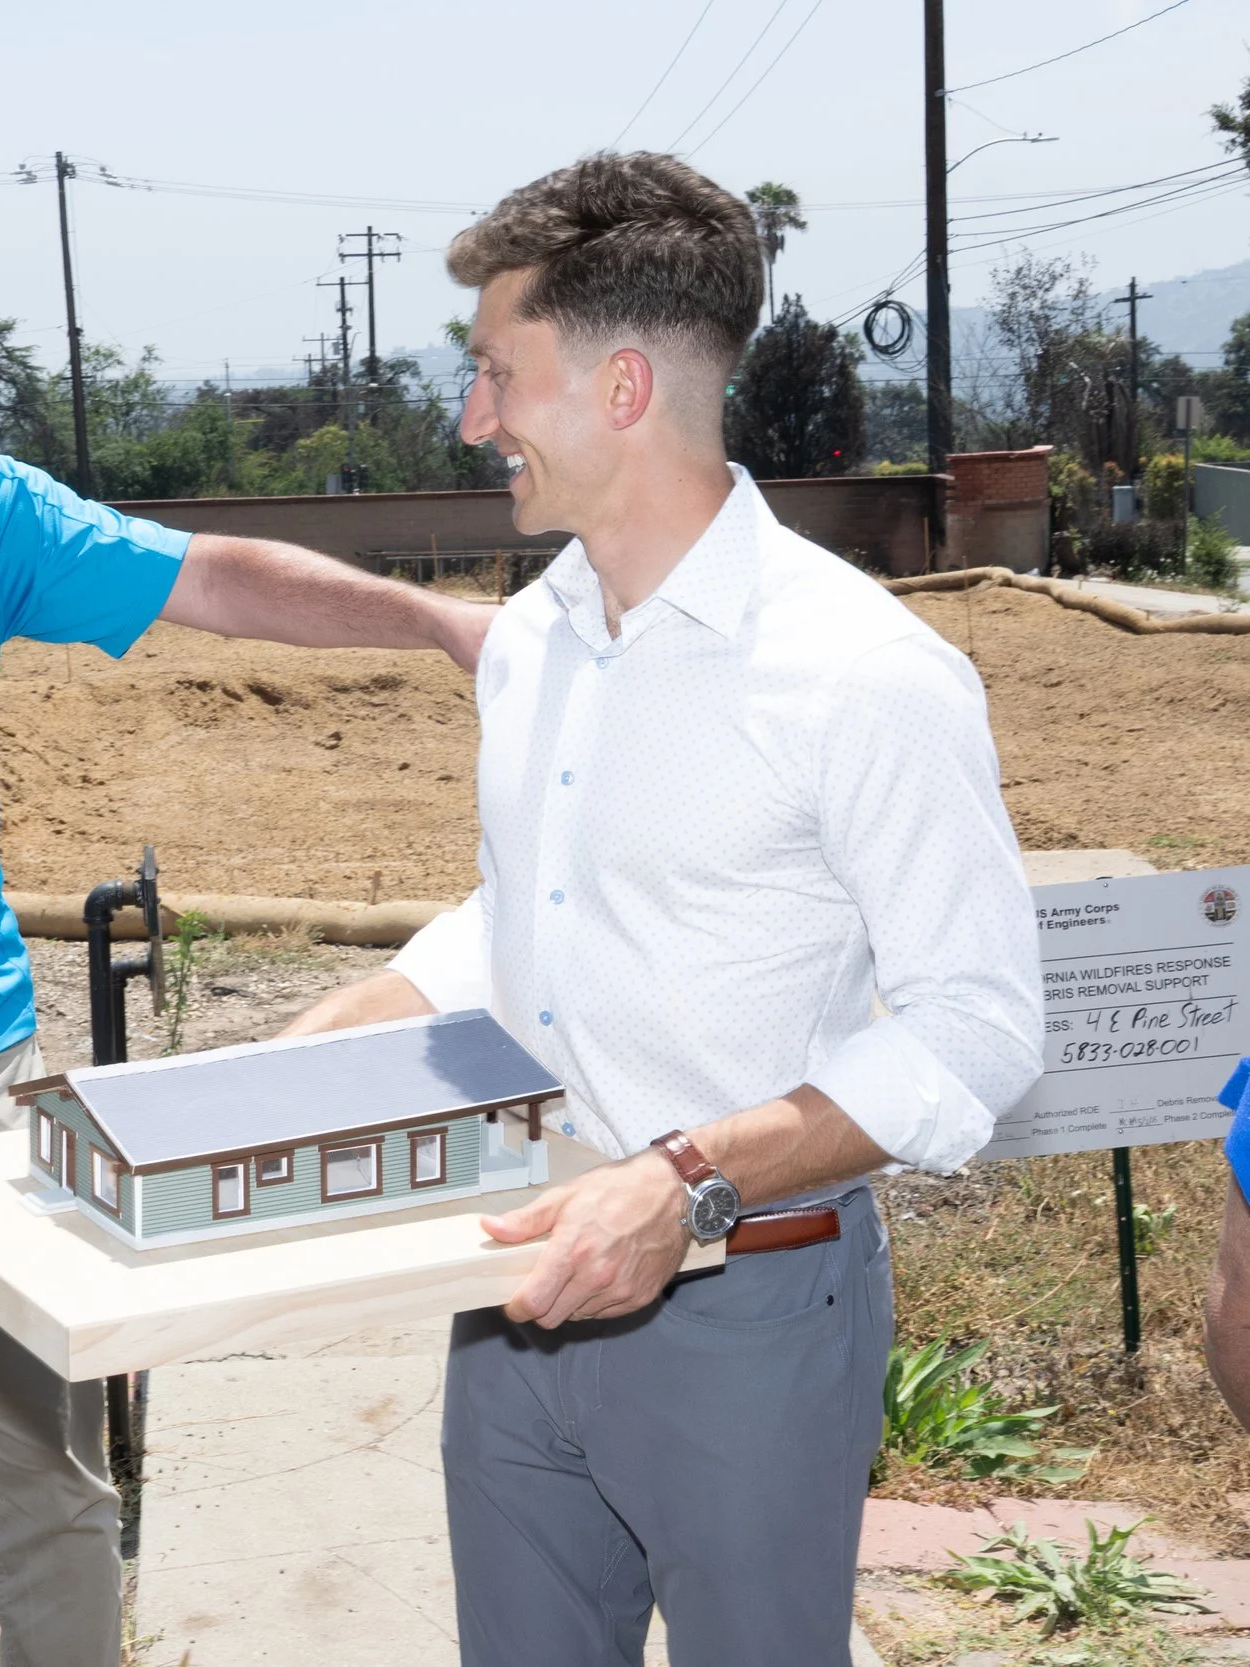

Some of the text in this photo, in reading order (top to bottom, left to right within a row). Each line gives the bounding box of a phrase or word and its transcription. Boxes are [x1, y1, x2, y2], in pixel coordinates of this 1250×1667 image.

[1051, 907, 1081, 917] Army
[1085, 903, 1120, 914] Corps
[1047, 917, 1106, 931] Engineers
[1080, 963, 1153, 981] WILDFIRES
[1156, 956, 1231, 973] RESPONSE
[1077, 981, 1142, 998] REMOVAL
[1145, 974, 1210, 991] SUPPORT
[1086, 1010, 1102, 1032] 4
[1131, 1007, 1171, 1029] Pine
[1178, 998, 1239, 1028] Street
[1157, 1098, 1184, 1107] Debris
[1034, 1108, 1078, 1119] Authorized
[1164, 1114, 1190, 1122] Phase
[1032, 1127, 1058, 1136] Phase
[1069, 1122, 1107, 1134] Complete
